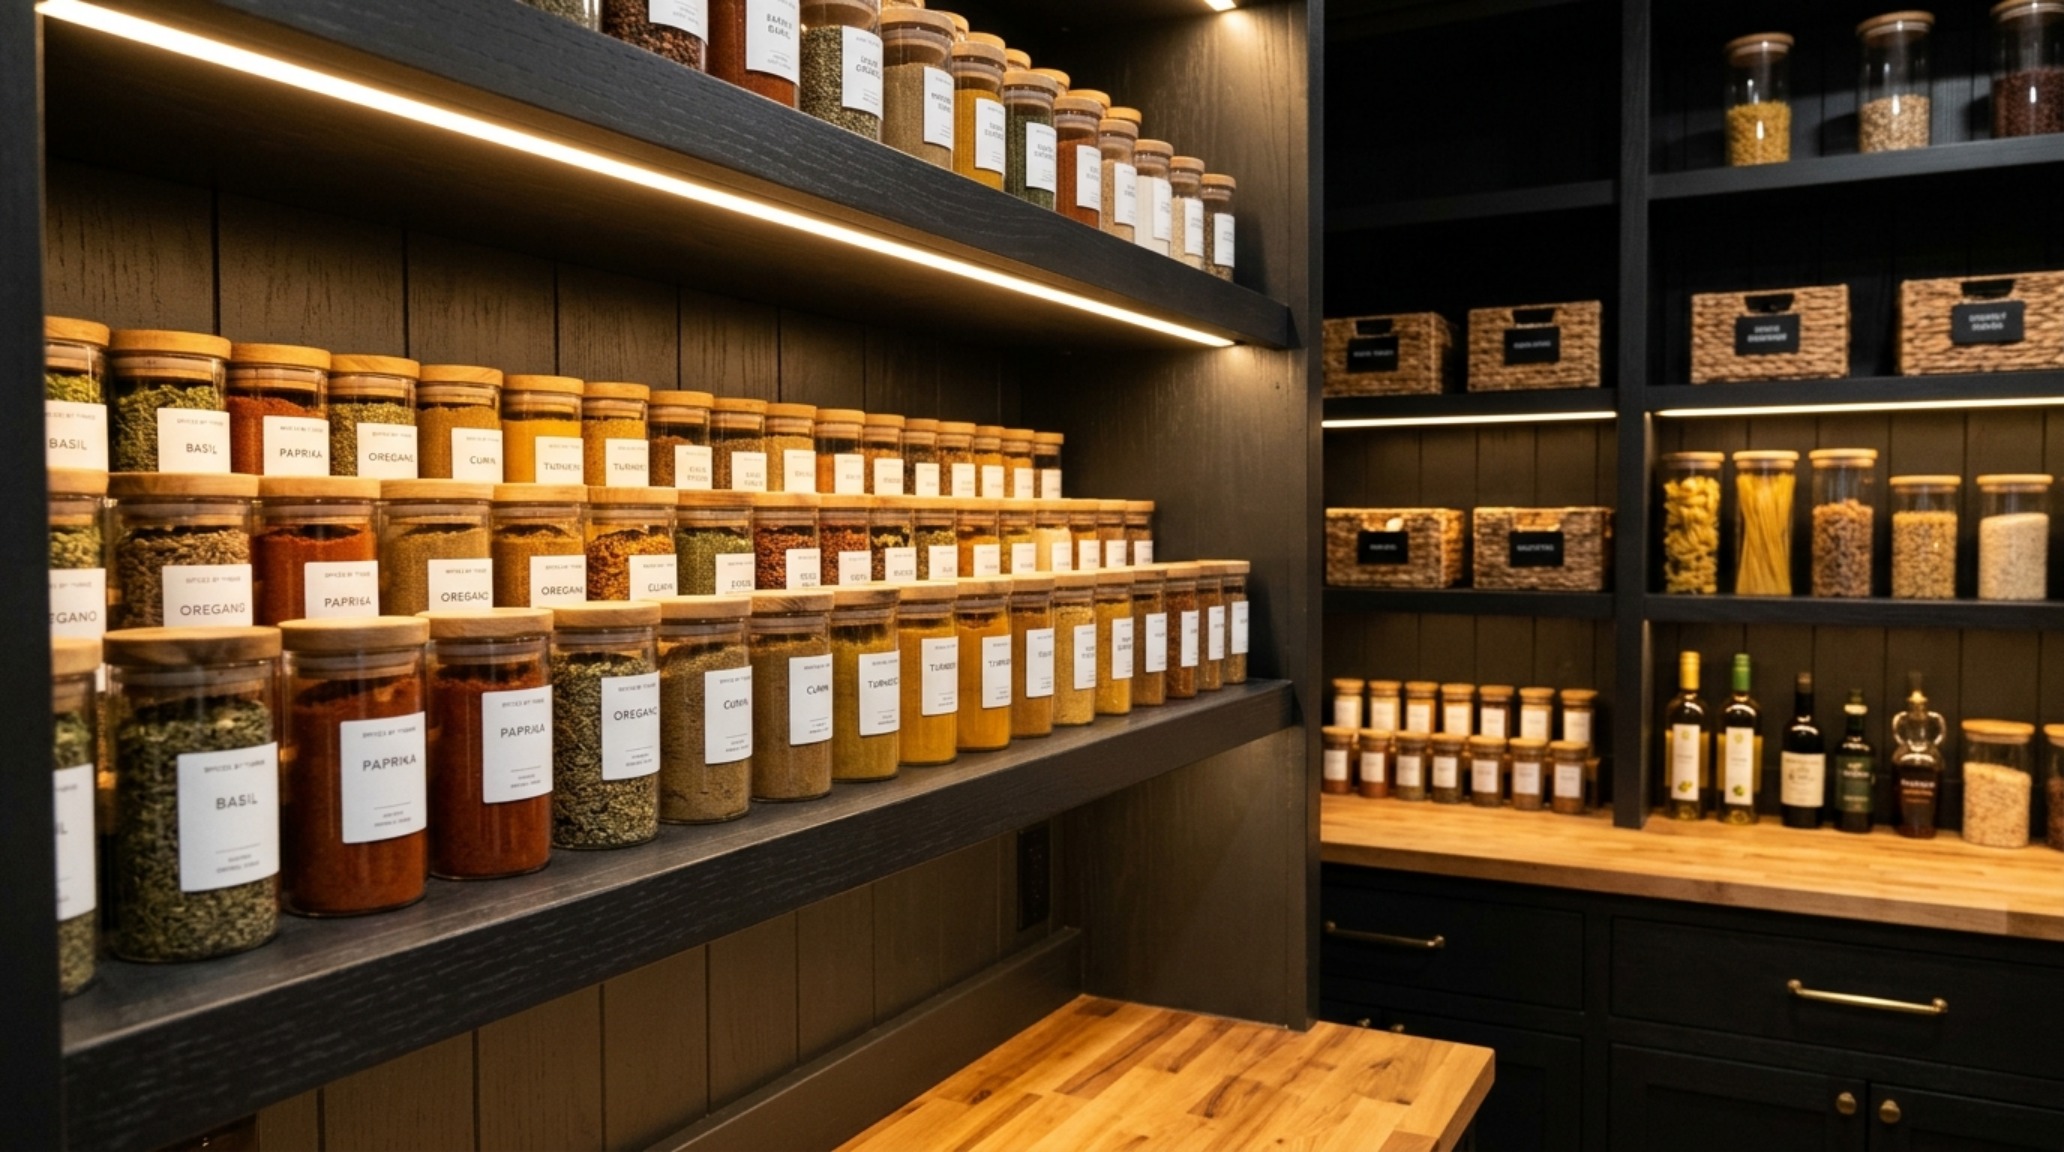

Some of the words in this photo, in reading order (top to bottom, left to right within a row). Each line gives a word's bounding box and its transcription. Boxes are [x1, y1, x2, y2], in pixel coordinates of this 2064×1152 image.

[49, 437, 88, 451] BASIL
[186, 443, 218, 455] BASIL
[362, 754, 417, 772] PAPRIKA
[215, 792, 258, 811] BASIL
